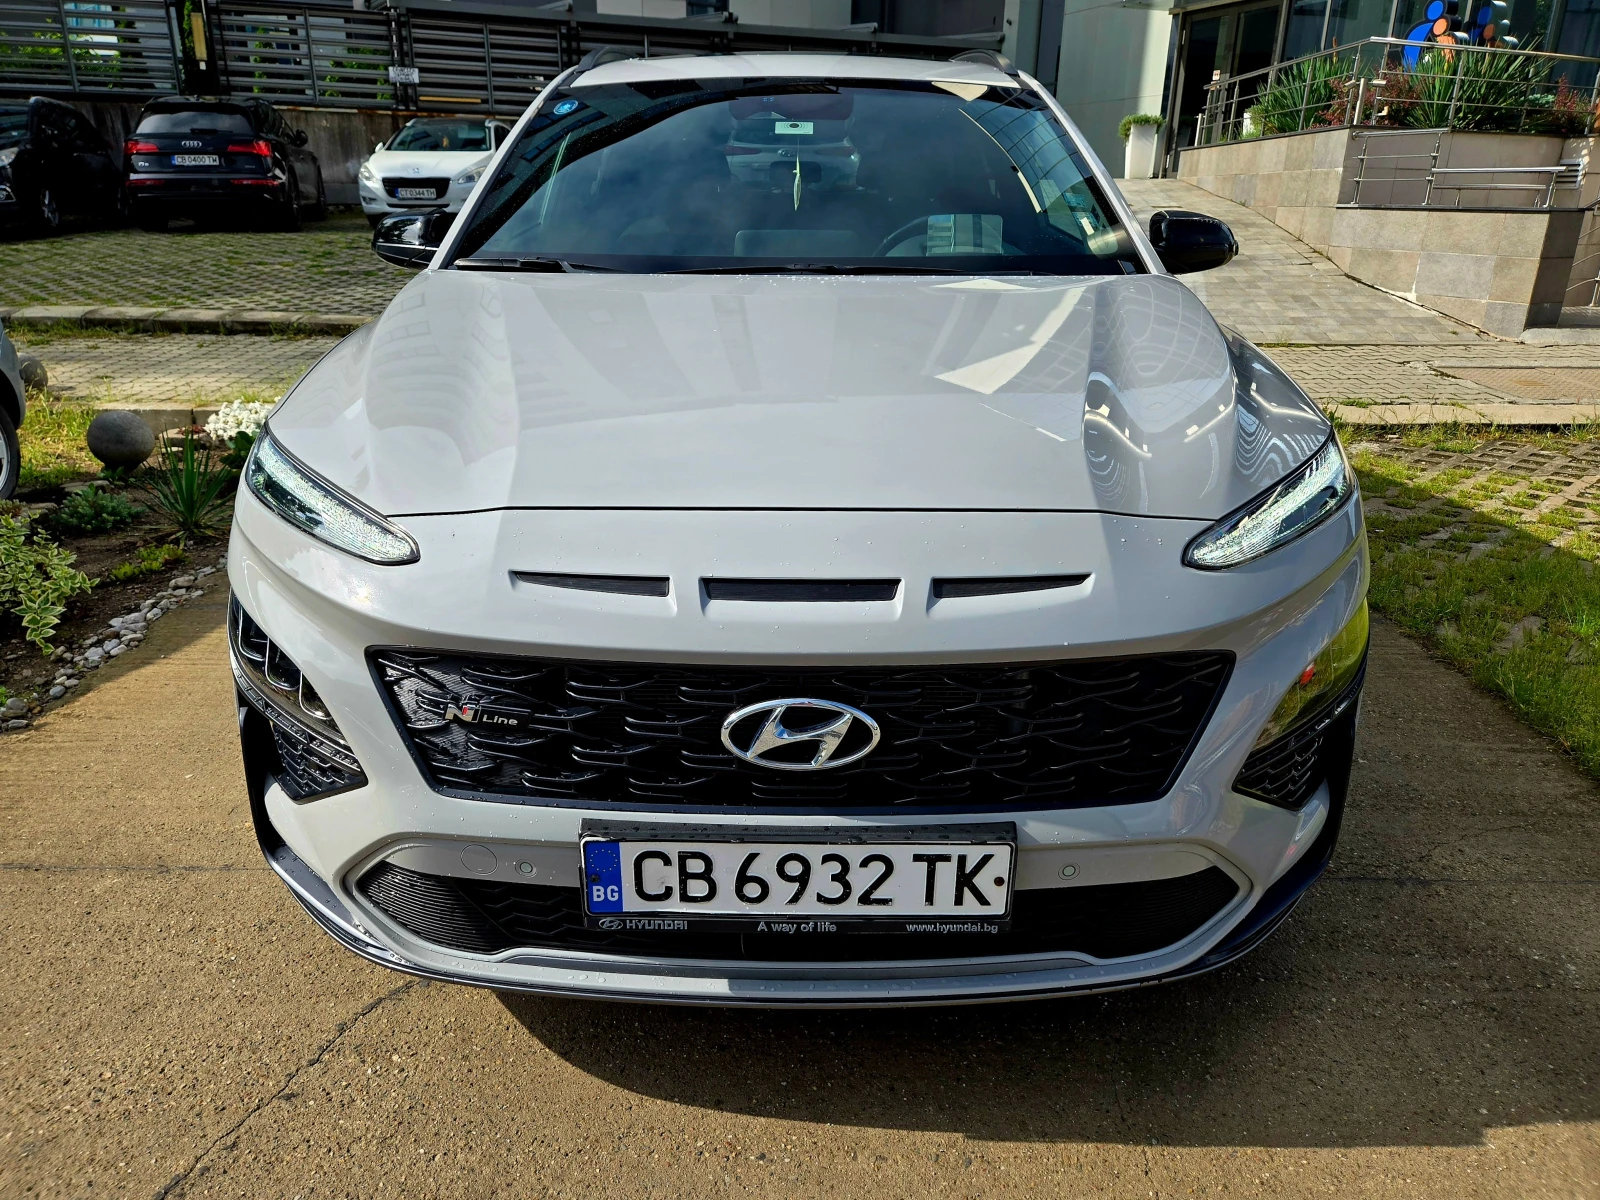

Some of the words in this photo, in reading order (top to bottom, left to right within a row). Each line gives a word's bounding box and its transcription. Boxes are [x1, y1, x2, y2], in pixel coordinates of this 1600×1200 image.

[482, 714, 518, 726] Line
[633, 850, 717, 903] CB
[734, 852, 894, 906] 6932
[912, 853, 995, 906] TK
[592, 885, 619, 902] BG
[626, 920, 688, 931] HYUNDAI
[757, 921, 768, 932] A
[771, 922, 797, 934] way
[800, 921, 815, 932] of
[817, 921, 837, 932] life
[906, 922, 999, 934] www.hyundai.bg
